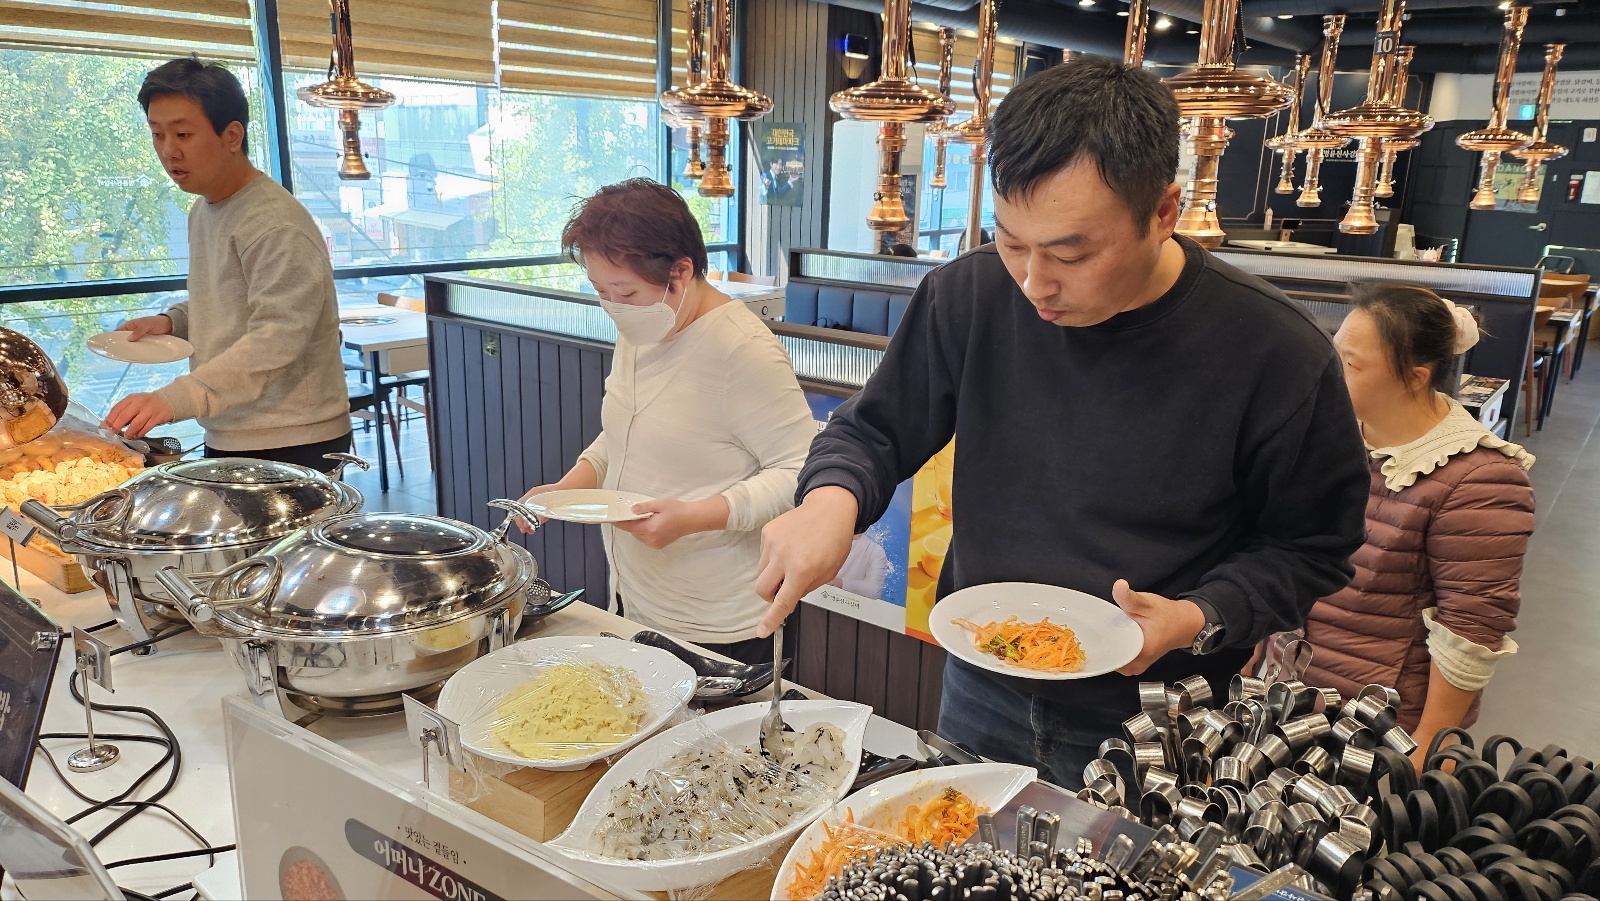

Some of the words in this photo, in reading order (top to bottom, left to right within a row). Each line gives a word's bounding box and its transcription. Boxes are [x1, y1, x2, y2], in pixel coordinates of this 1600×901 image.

[1377, 37, 1393, 53] 10
[1323, 149, 1357, 159] 명륜진사갈
[404, 826, 431, 849] 맛있는
[433, 841, 459, 864] 곁들임
